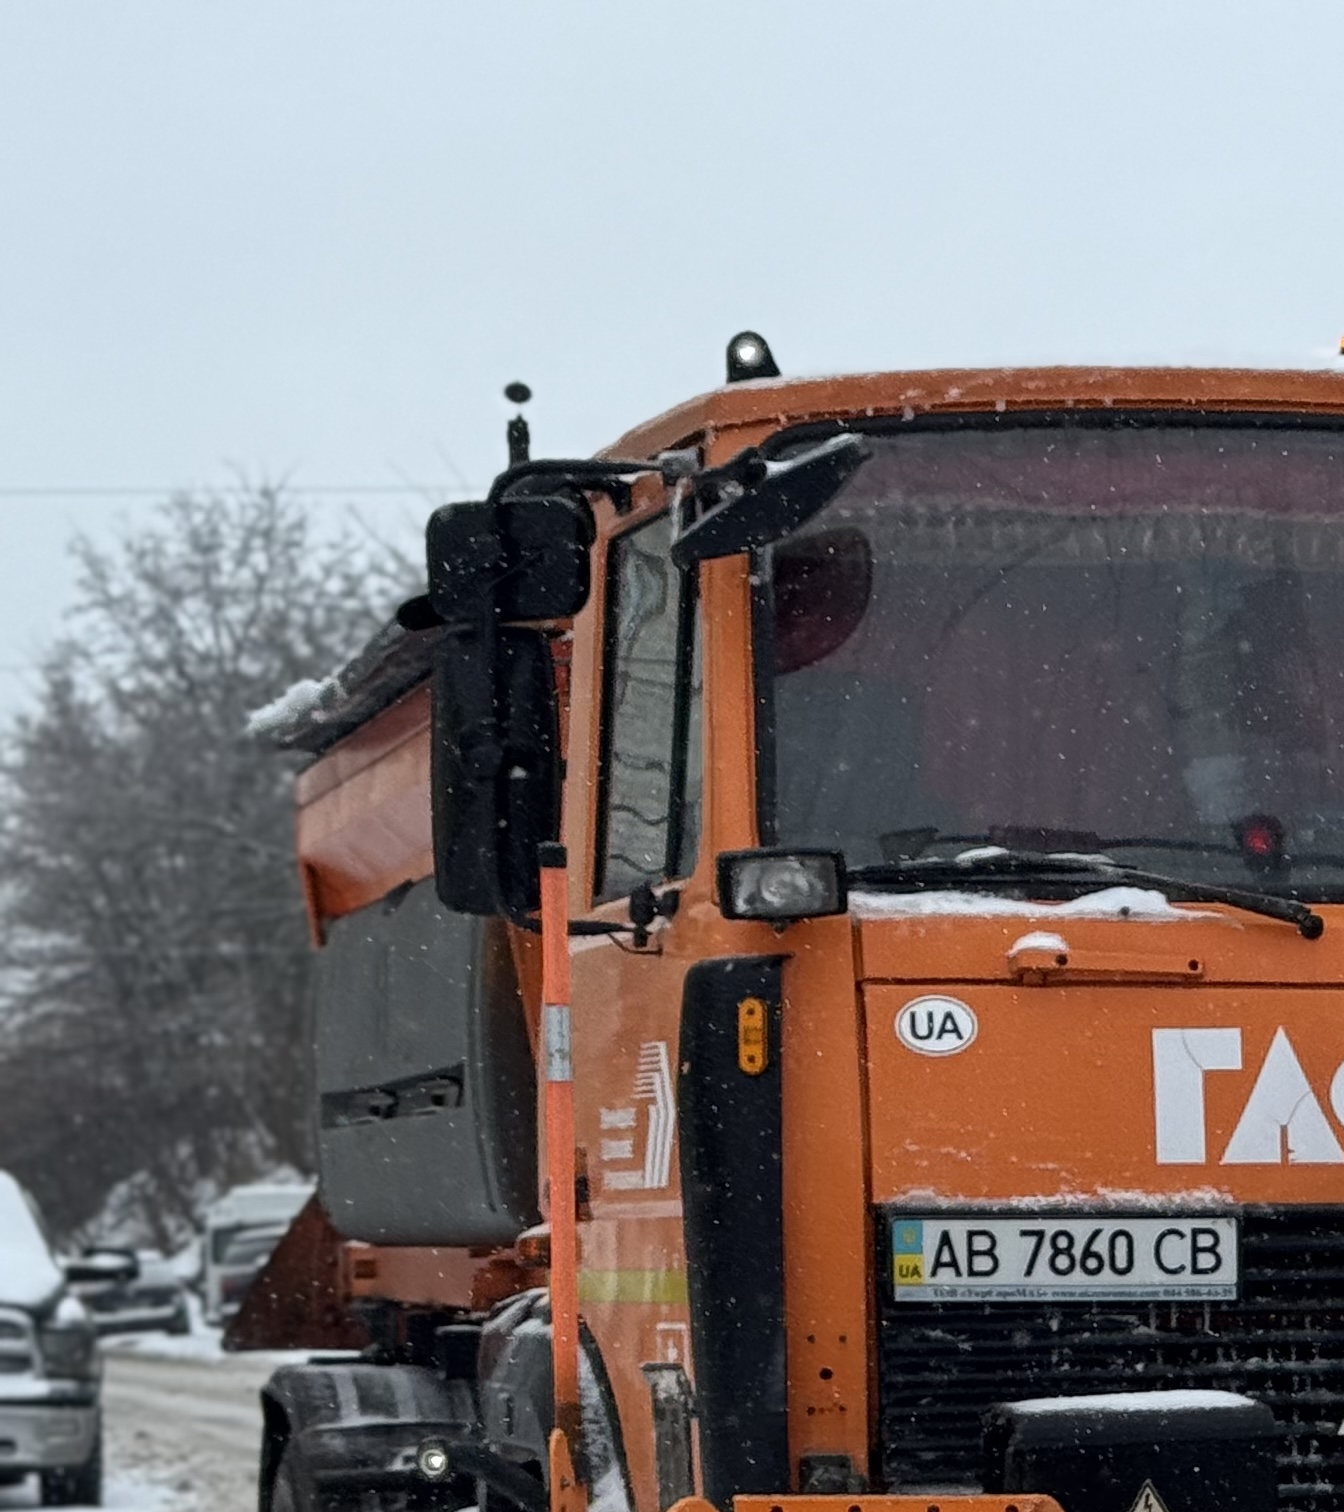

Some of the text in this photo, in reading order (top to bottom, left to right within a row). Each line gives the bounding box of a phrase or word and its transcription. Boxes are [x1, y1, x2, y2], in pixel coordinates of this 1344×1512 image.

[909, 1010, 963, 1040] UA
[930, 1227, 1223, 1278] AB 7860 CB
[898, 1264, 922, 1279] UA
